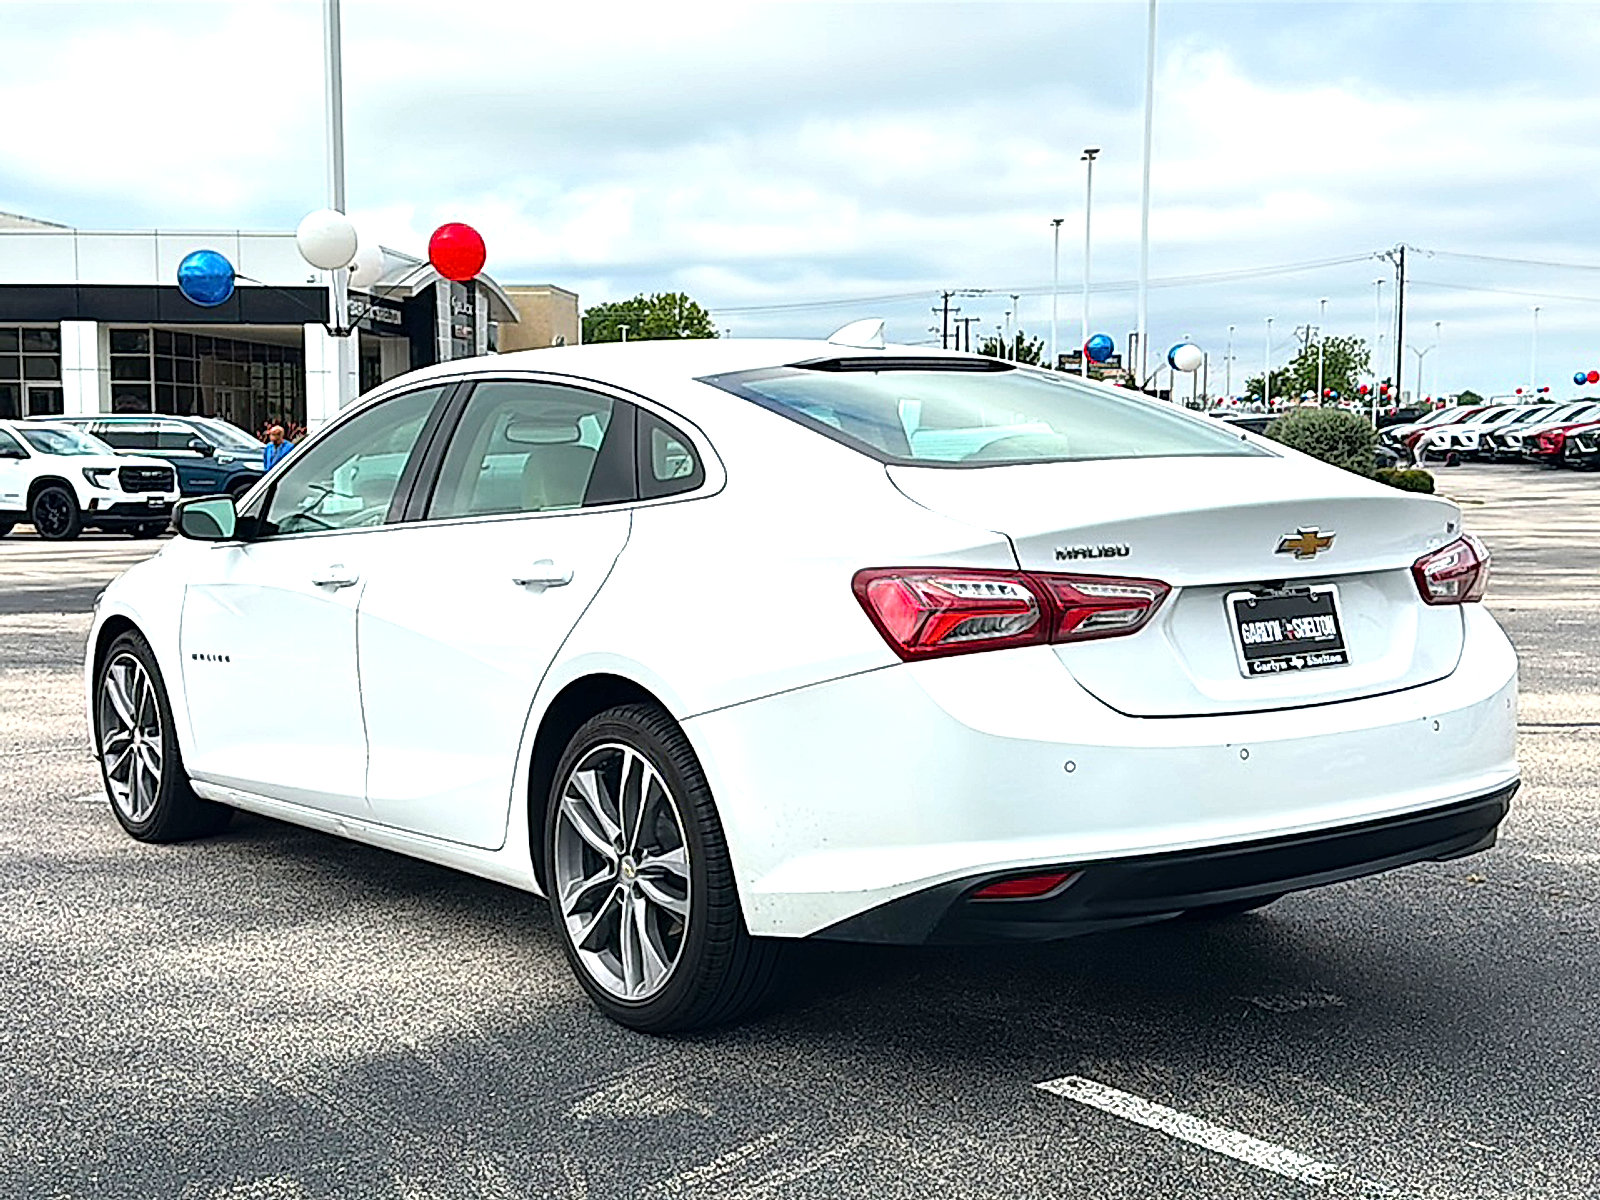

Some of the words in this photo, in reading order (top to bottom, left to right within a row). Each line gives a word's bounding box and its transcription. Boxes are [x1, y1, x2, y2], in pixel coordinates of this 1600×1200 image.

[1055, 545, 1131, 561] MALIBU
[1241, 619, 1283, 644] GARLYN
[1291, 614, 1337, 639] SHELTON
